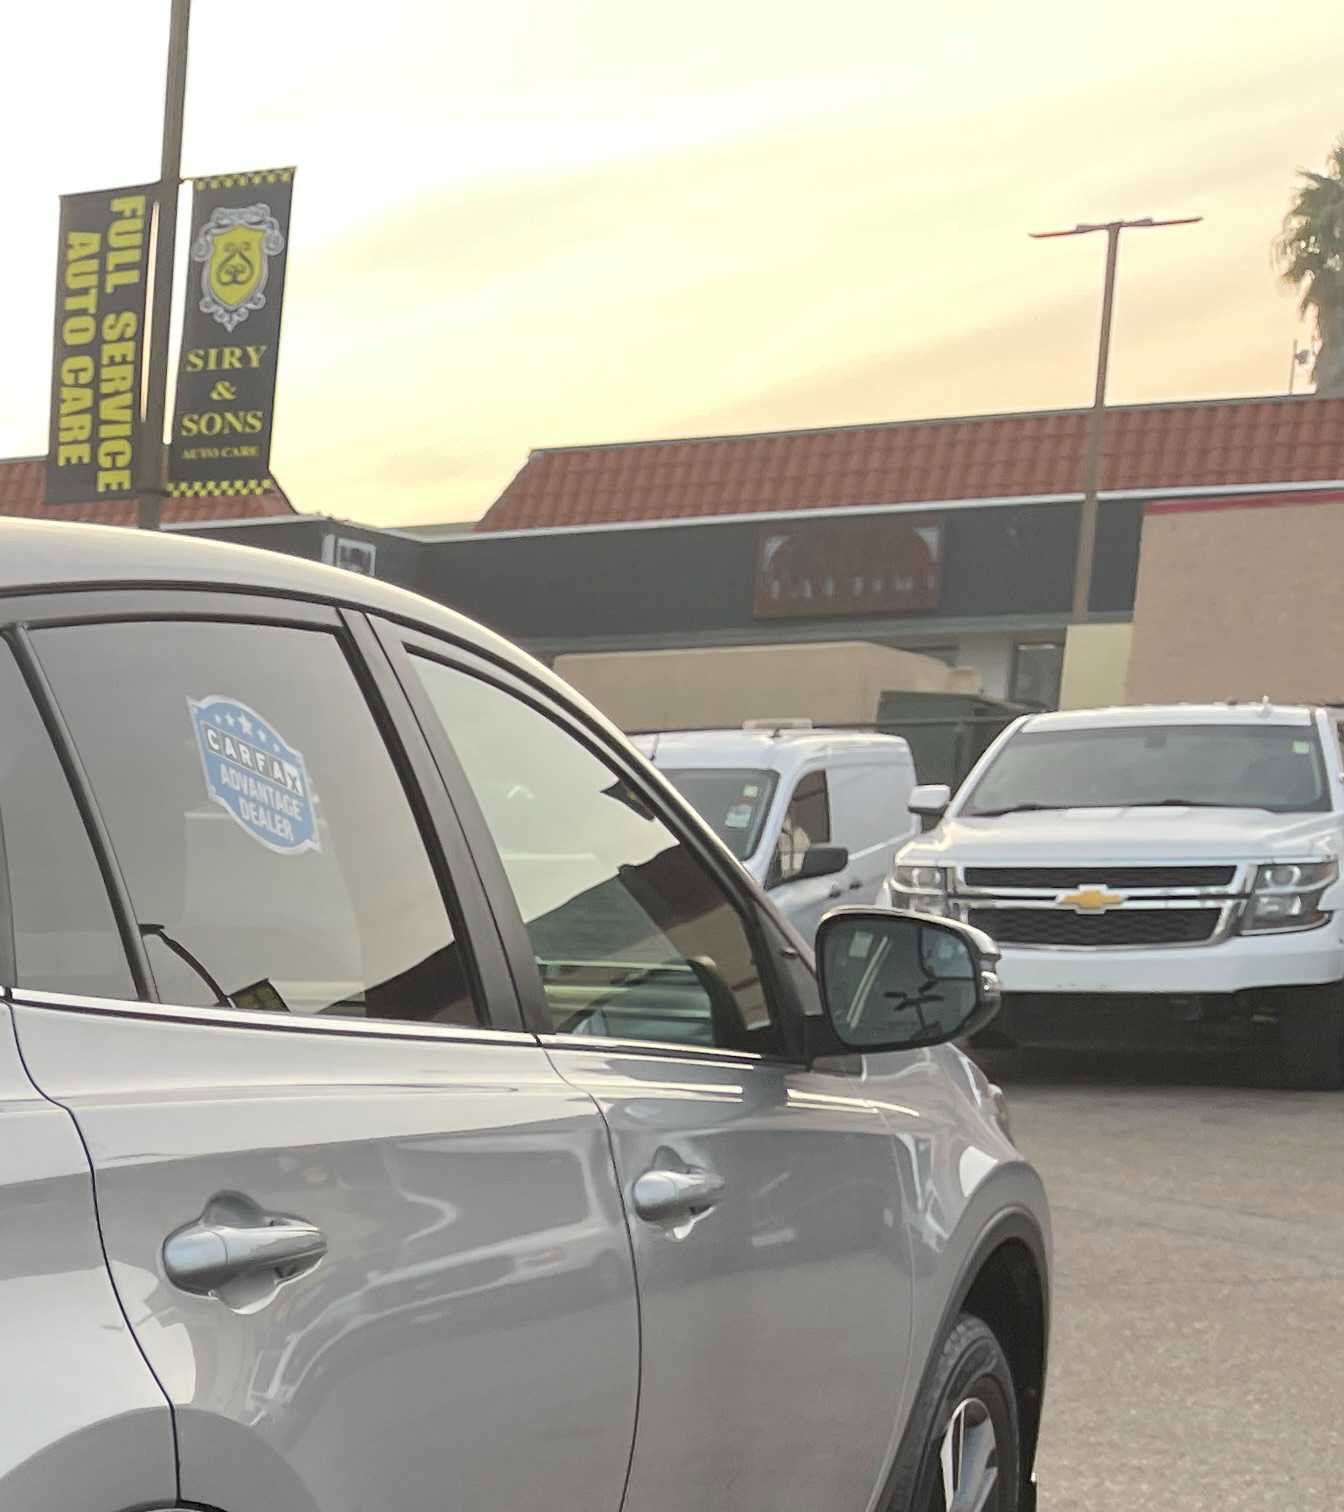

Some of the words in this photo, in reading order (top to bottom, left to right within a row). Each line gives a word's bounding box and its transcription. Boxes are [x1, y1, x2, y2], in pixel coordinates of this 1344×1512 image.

[106, 195, 146, 294] FULL
[62, 231, 102, 346] AUTO
[185, 345, 267, 373] SIRY
[58, 355, 95, 466] CARE
[96, 311, 139, 492] SERVICE
[209, 380, 237, 401] &
[180, 410, 264, 437] SONS
[206, 728, 303, 795] CARFAX
[220, 763, 303, 821] ADVANTAGE
[239, 798, 294, 841] DEALER
